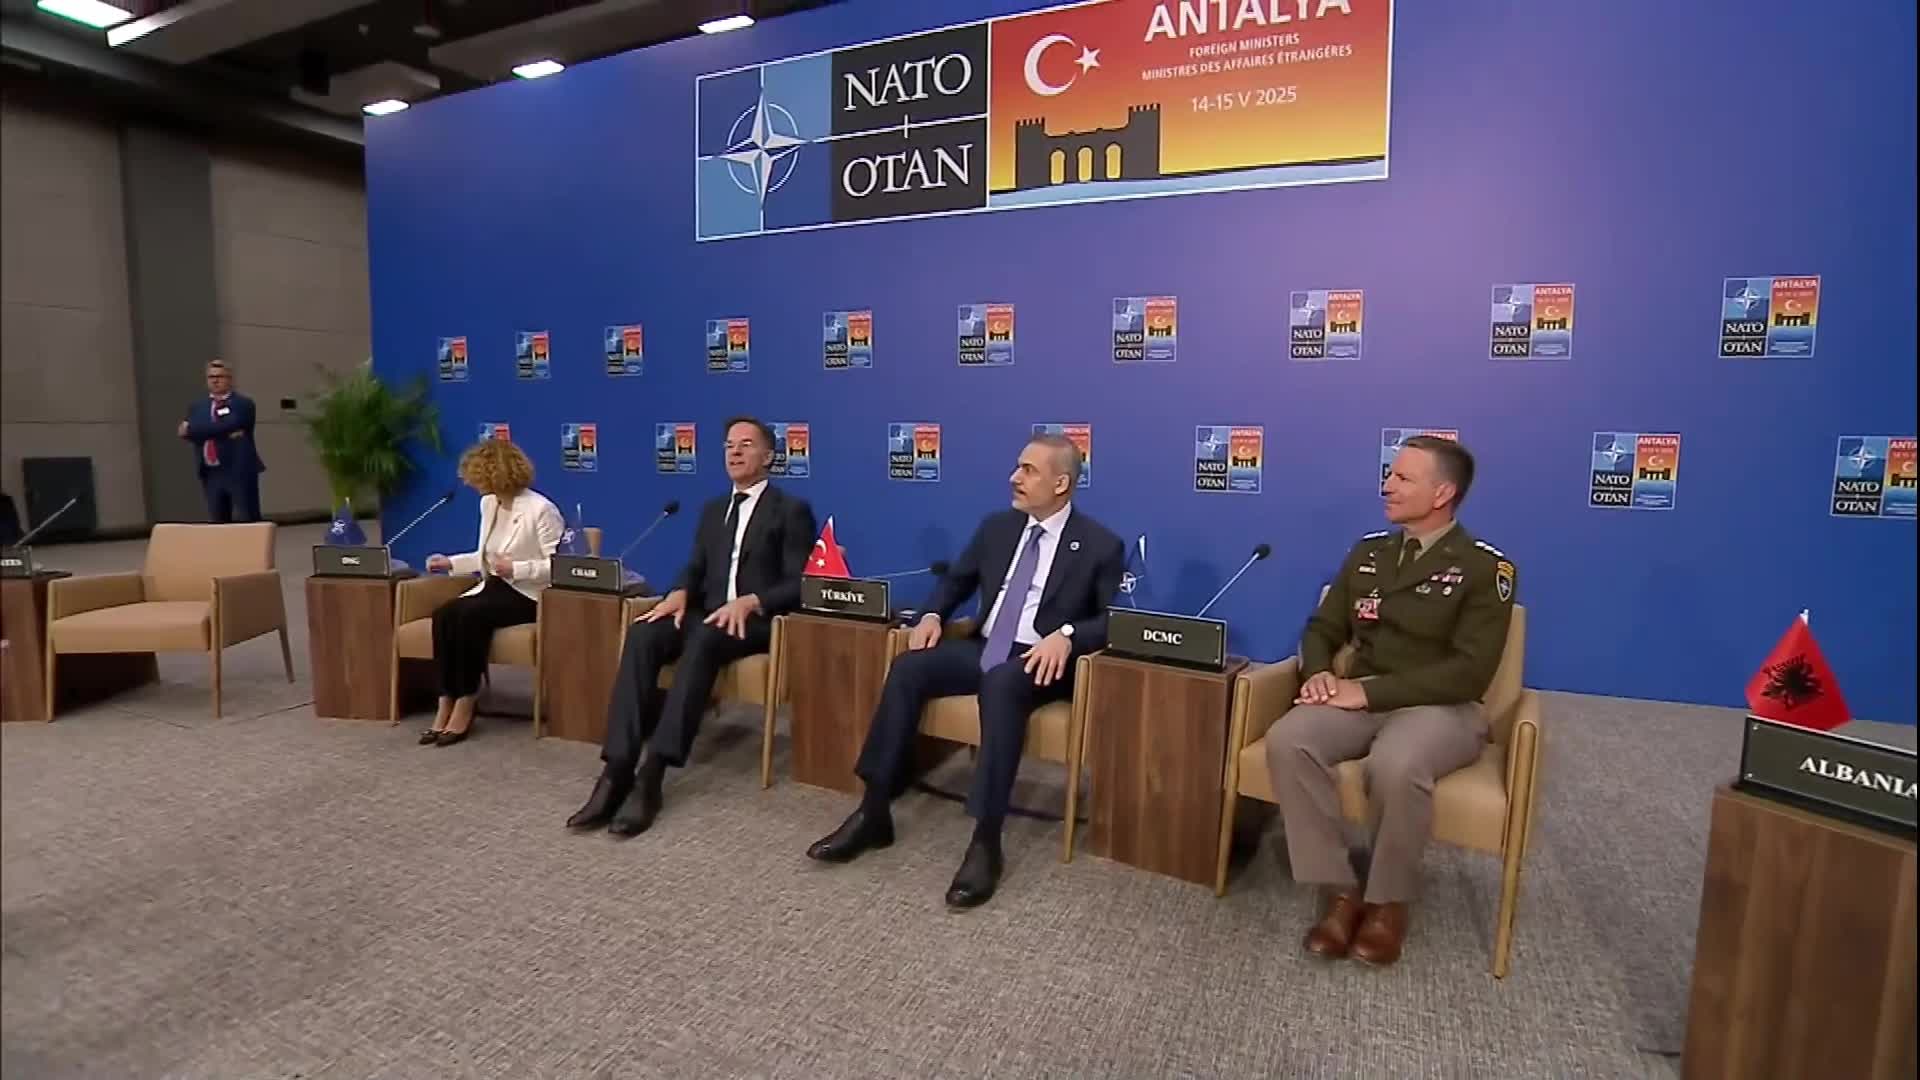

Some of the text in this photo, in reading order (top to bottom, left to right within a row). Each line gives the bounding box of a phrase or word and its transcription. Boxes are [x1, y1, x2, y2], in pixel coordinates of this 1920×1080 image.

[1189, 32, 1300, 58] FOREIGN MINISTERS
[1141, 63, 1198, 81] MINISTRES
[1199, 61, 1221, 74] DES
[1223, 52, 1275, 72] AFFAIRES
[843, 53, 973, 111] NATO
[1192, 86, 1297, 113] 14-15 V 2025
[842, 143, 973, 197] OTAN
[1495, 326, 1528, 337] NATO
[1726, 322, 1765, 333] NATO
[1294, 329, 1323, 339] NATO
[1292, 345, 1321, 356] OTAN
[1493, 343, 1527, 354] OTAN
[1723, 341, 1762, 353] OTAN
[1198, 461, 1226, 472] NATO
[1197, 477, 1225, 488] OTAN
[1595, 474, 1630, 485] NATO
[1838, 481, 1880, 493] NATO
[1592, 491, 1629, 503] OTAN
[1835, 500, 1877, 513] OTAN
[1143, 629, 1183, 645] DCMC
